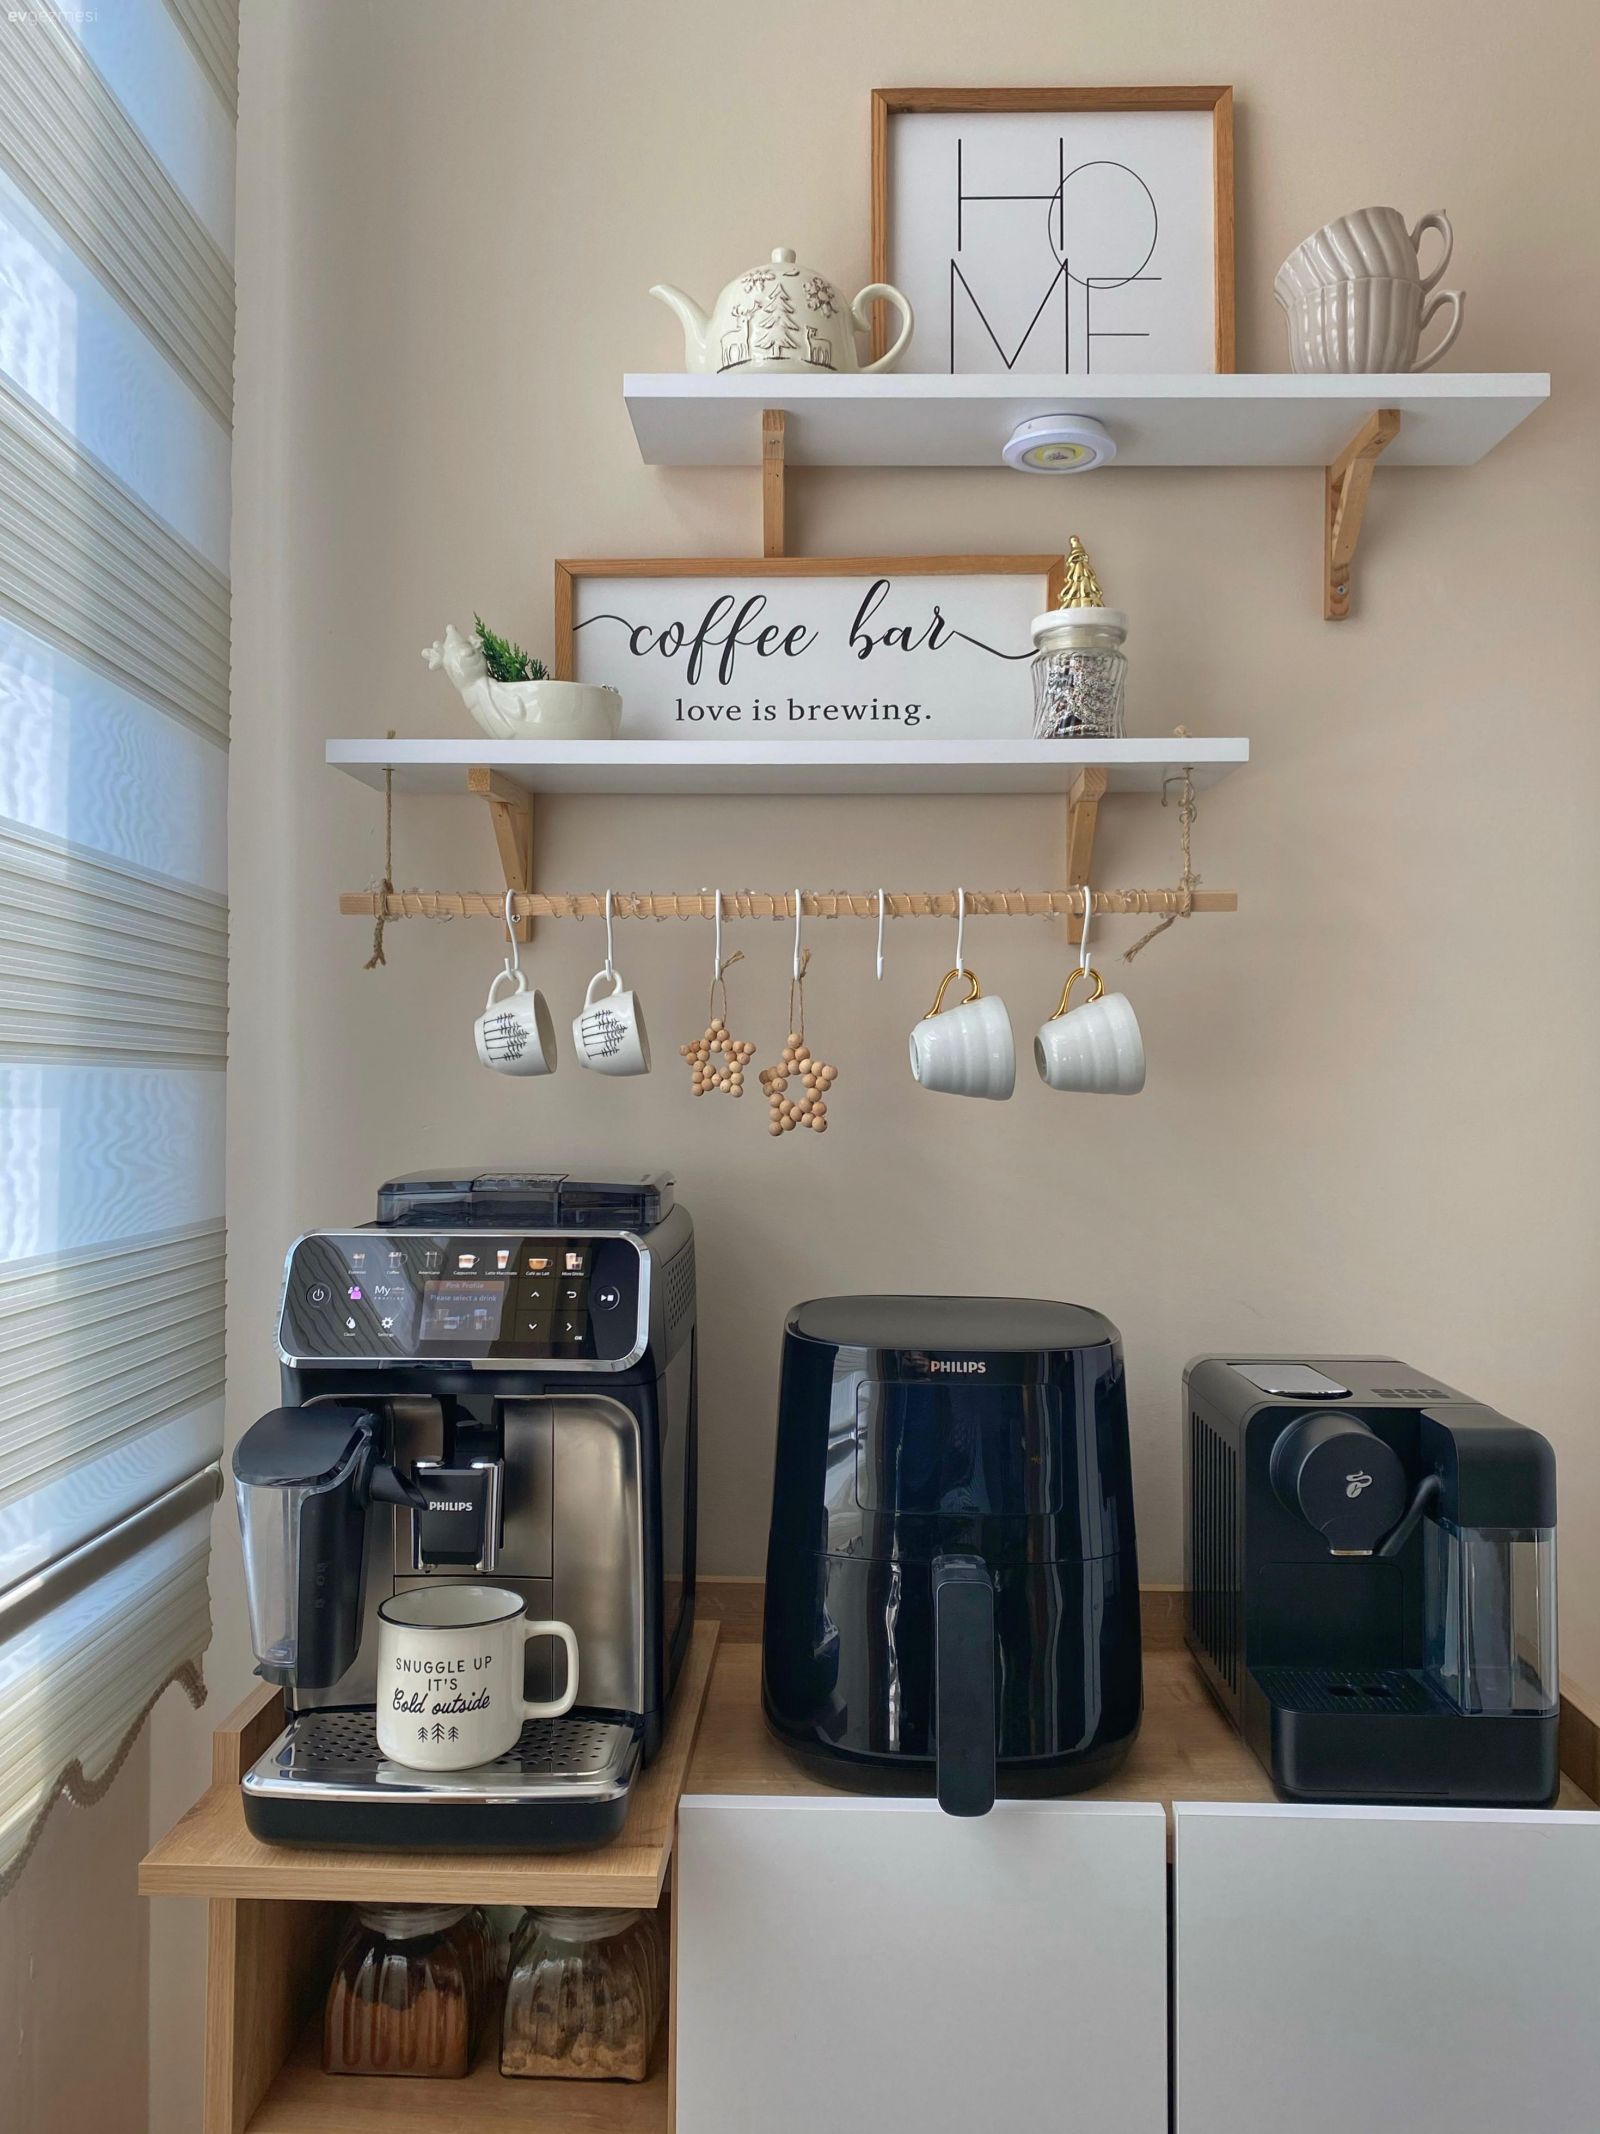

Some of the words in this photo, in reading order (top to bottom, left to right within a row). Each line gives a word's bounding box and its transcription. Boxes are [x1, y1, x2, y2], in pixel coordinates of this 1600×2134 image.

[573, 594, 818, 686] coffee
[849, 579, 1038, 660] bar
[675, 698, 742, 721] love
[752, 698, 777, 721] is
[787, 698, 932, 727] brewing.
[374, 1285, 391, 1297] My
[430, 1294, 451, 1302] Please
[930, 1360, 987, 1374] PHILIPS
[429, 1501, 473, 1512] PHILIPS
[395, 1657, 466, 1674] SNUGGLE
[473, 1655, 492, 1670] UP
[428, 1678, 458, 1692] IT'S
[392, 1688, 428, 1714] Cold
[432, 1687, 491, 1715] outside
